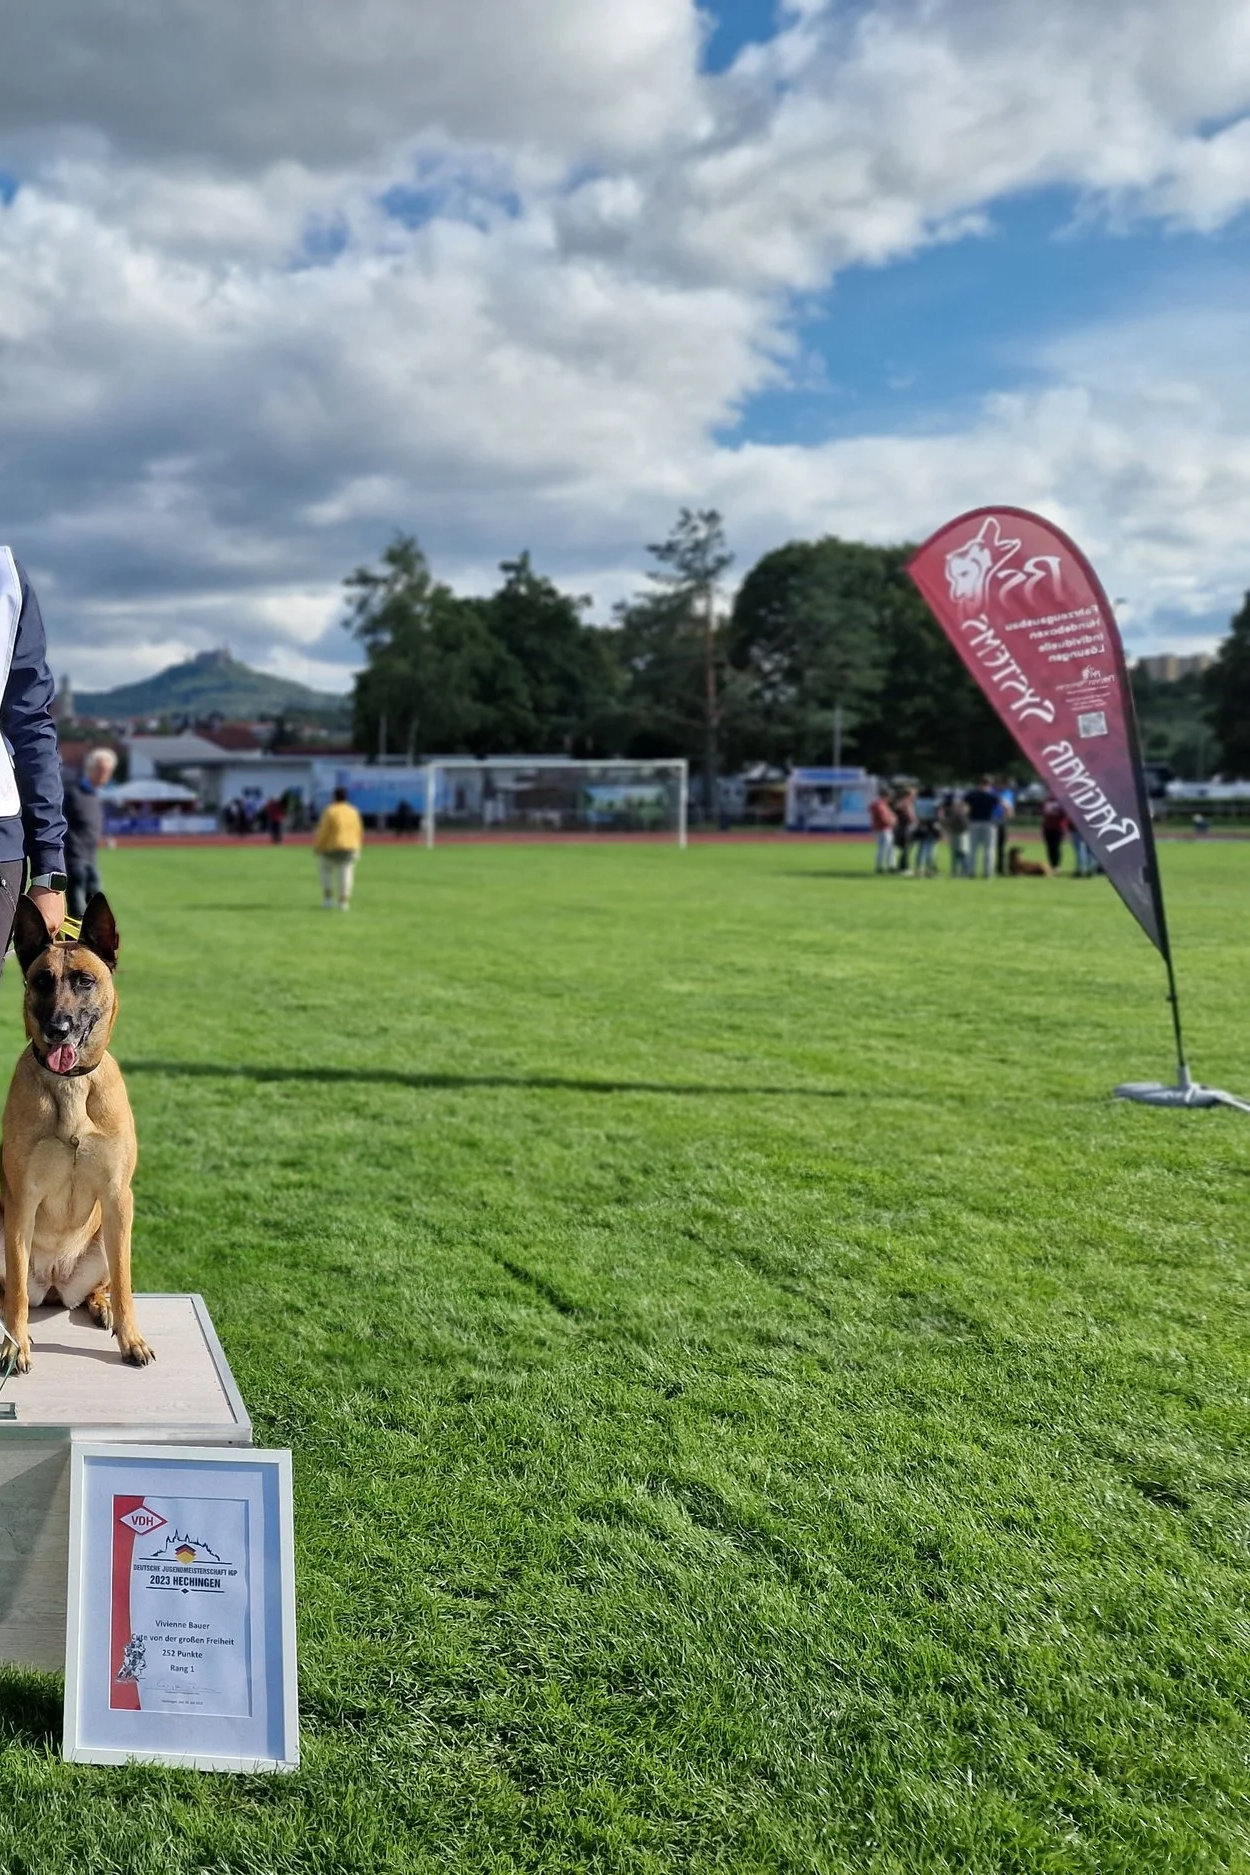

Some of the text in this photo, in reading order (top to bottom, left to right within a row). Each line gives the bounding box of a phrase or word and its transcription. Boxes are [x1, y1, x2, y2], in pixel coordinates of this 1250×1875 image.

[131, 1516, 154, 1526] VDH
[134, 1564, 238, 1577] DEUTSCHE JUGENDMEISTERSCHAFT IGP
[150, 1575, 221, 1588] 2023 HECHINGEN
[155, 1620, 210, 1630] Vivienne Bauer
[165, 1635, 177, 1643] der
[179, 1636, 205, 1645] großen
[206, 1638, 234, 1646] Freiheit
[162, 1649, 203, 1659] 252 Punkte
[170, 1665, 196, 1674] Rang 1
